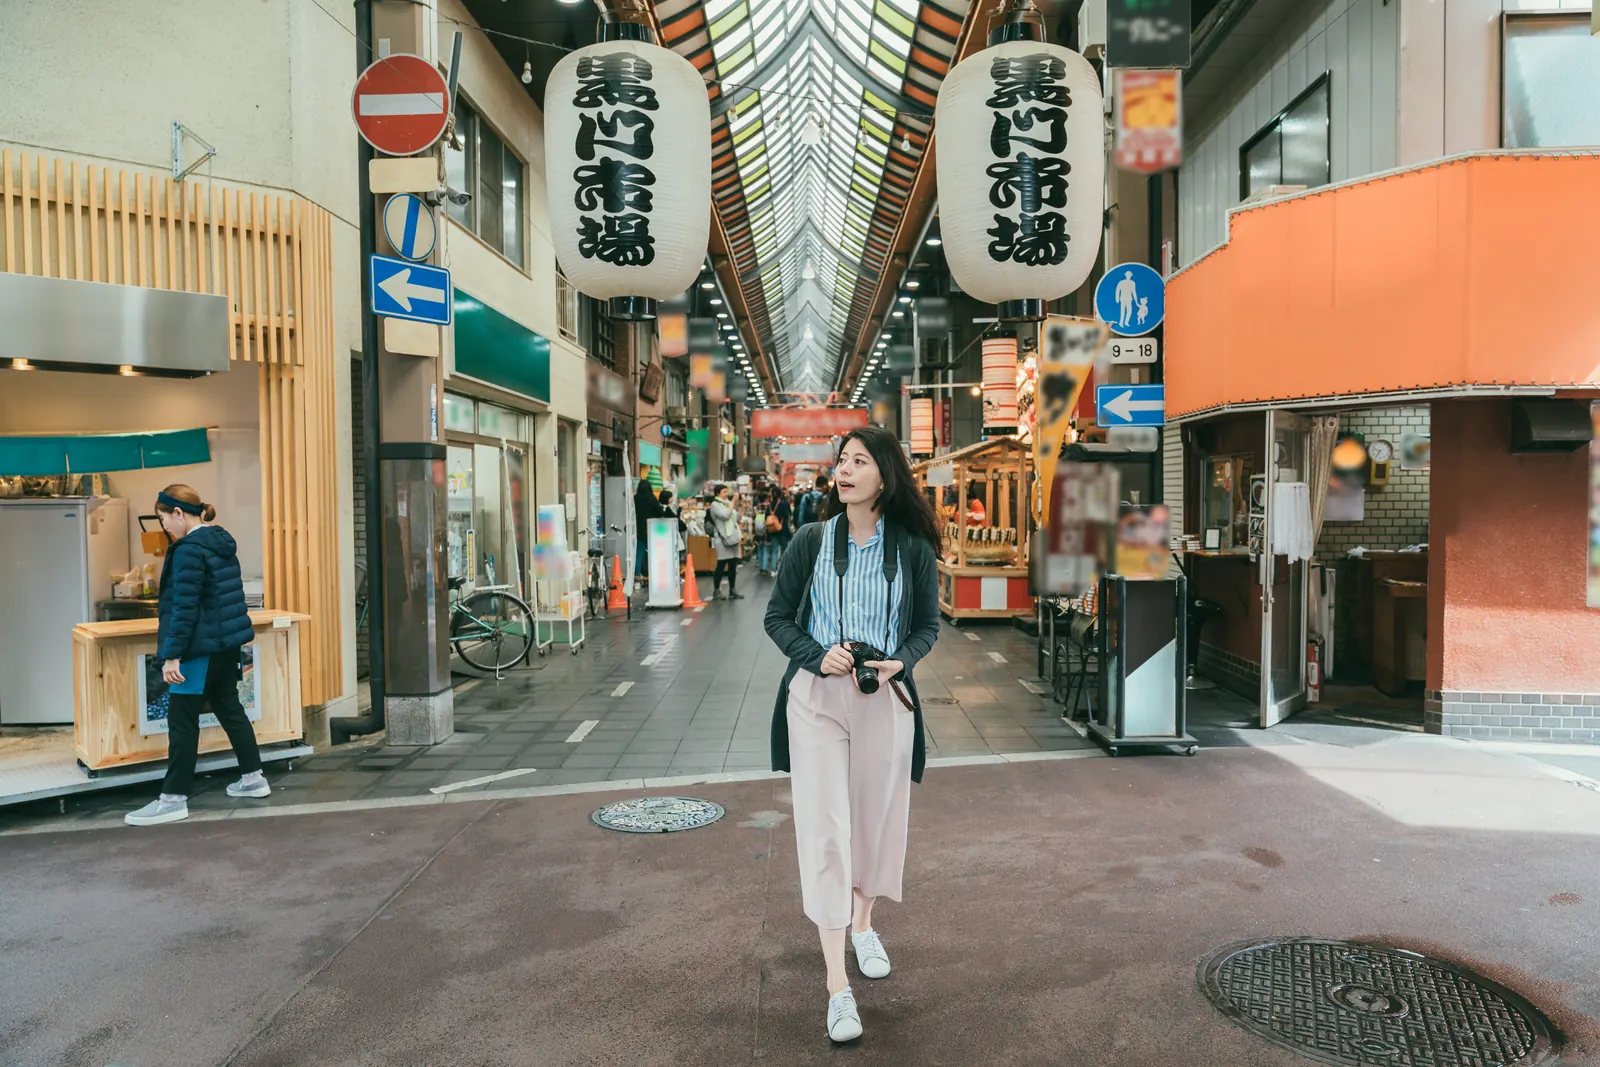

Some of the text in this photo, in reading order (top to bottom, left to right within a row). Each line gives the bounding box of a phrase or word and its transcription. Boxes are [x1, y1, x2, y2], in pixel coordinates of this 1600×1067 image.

[572, 52, 660, 266] 黒門市場
[985, 53, 1073, 266] 黒門市場
